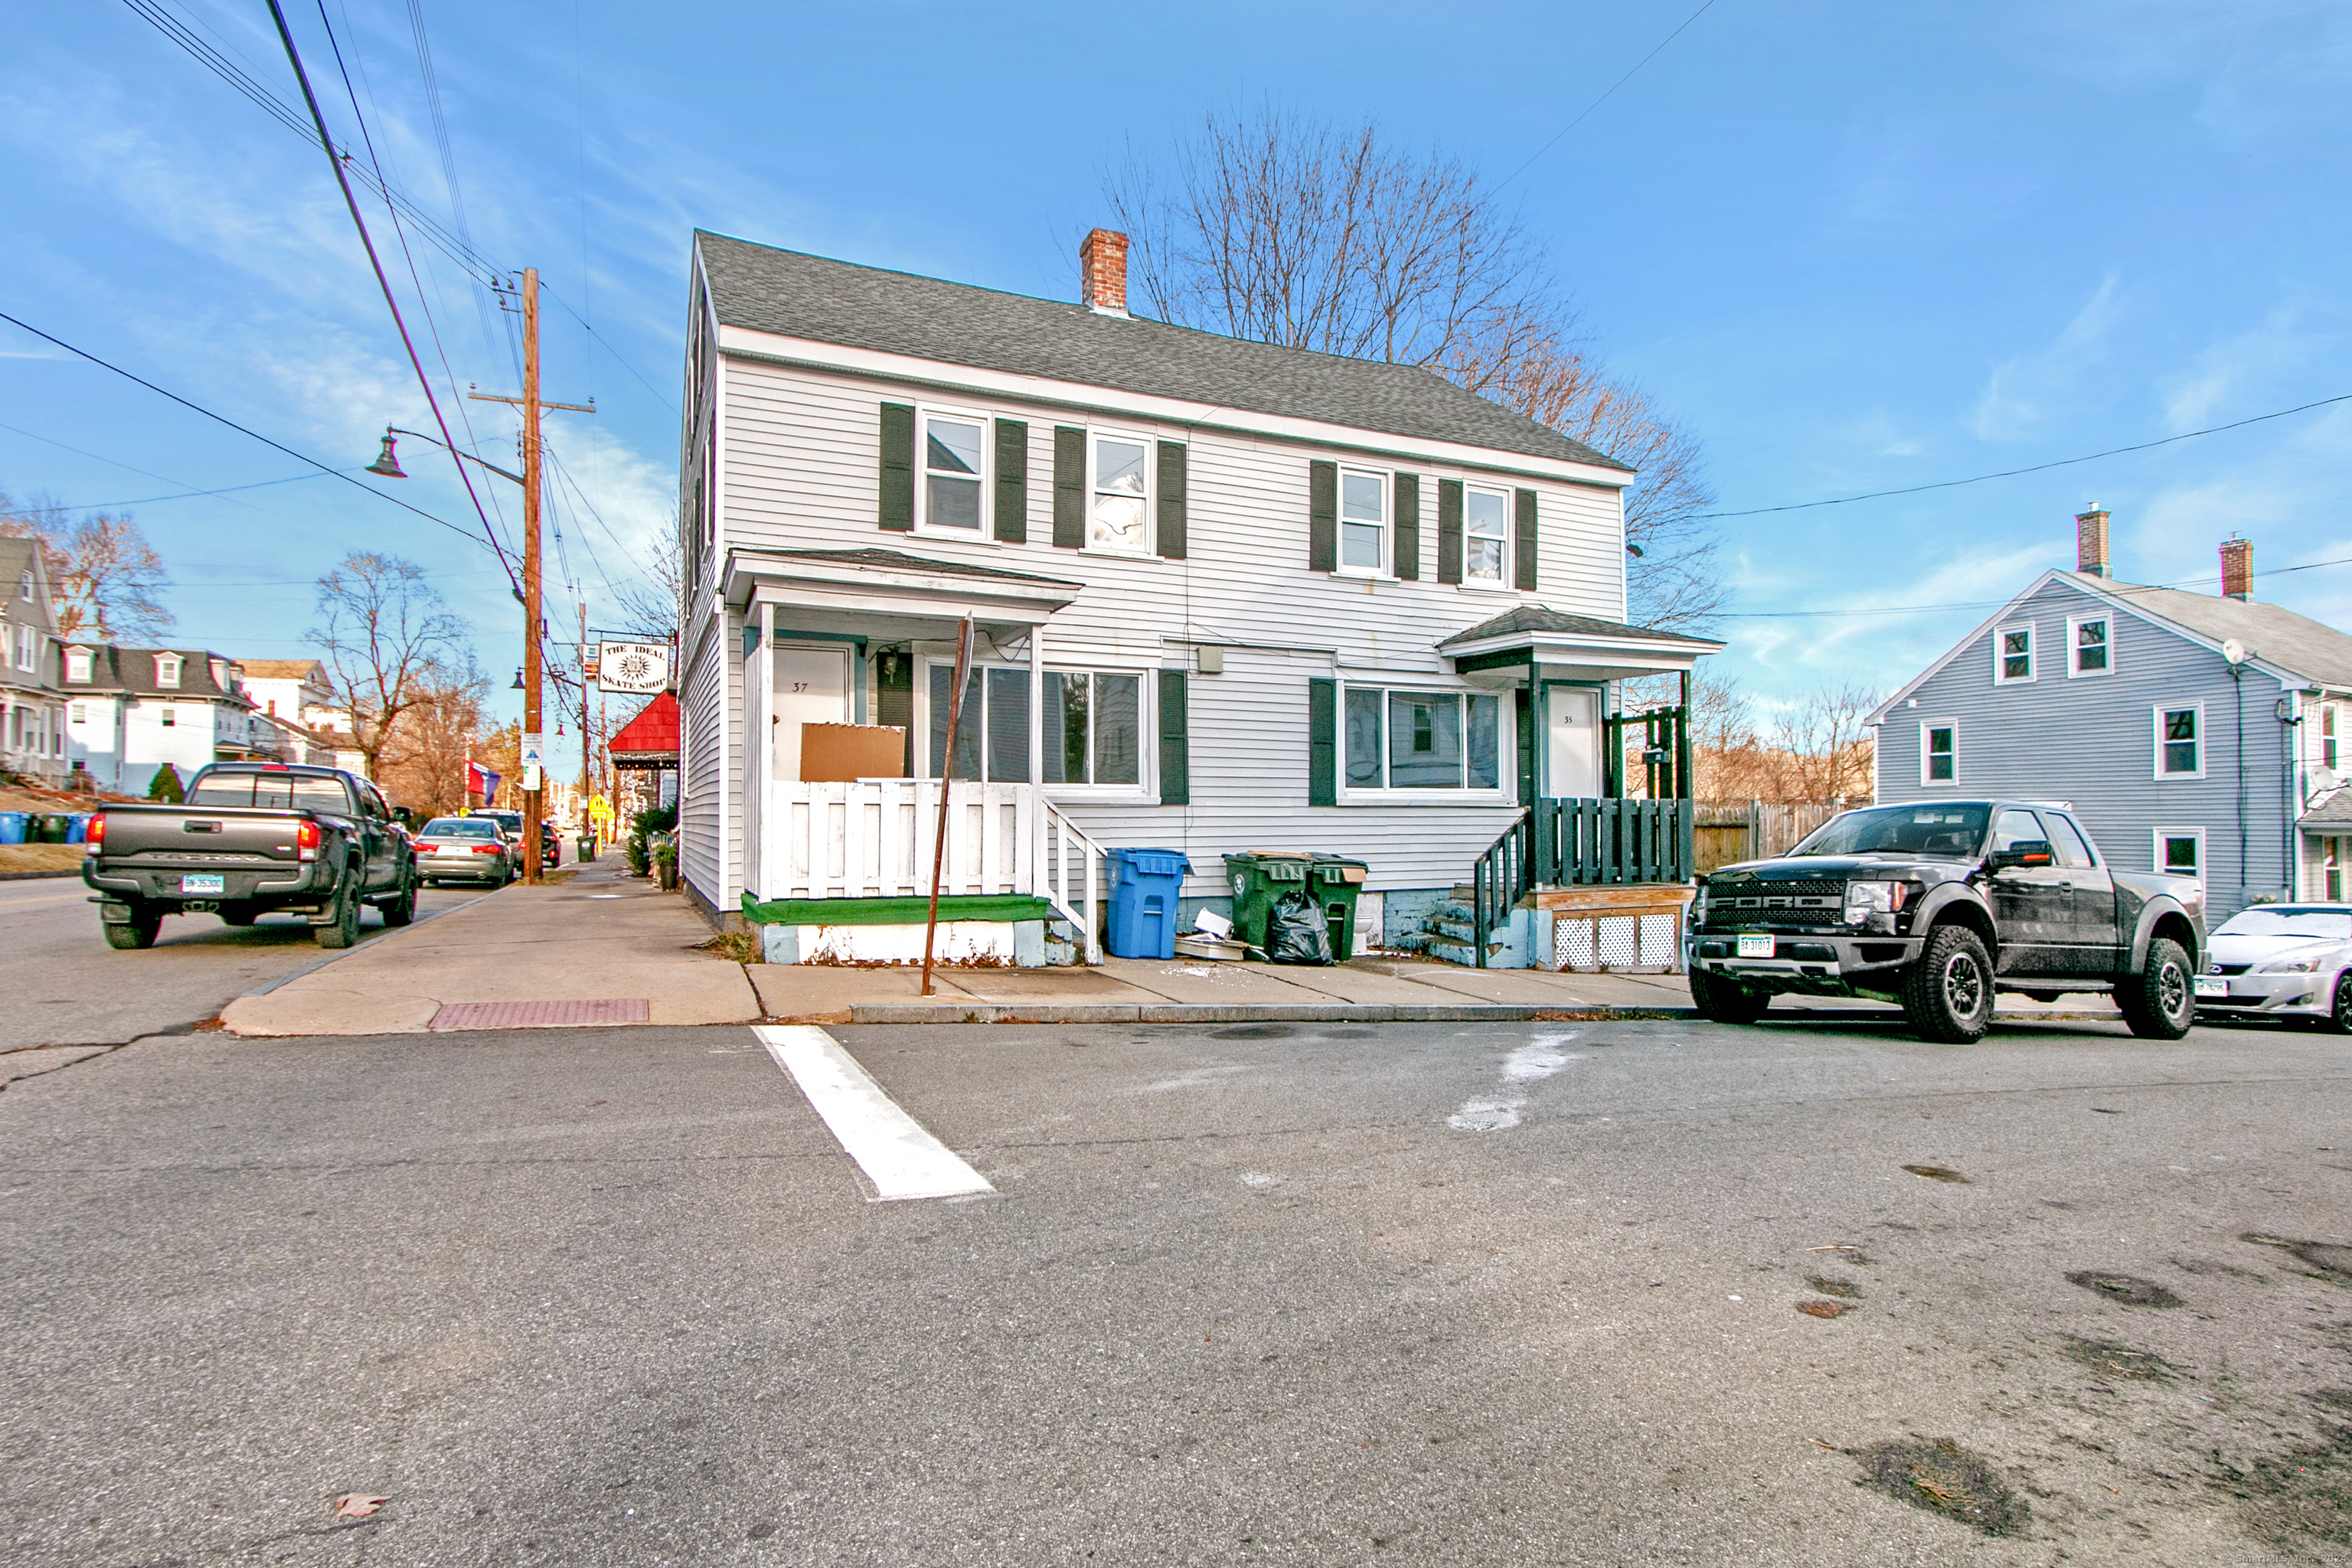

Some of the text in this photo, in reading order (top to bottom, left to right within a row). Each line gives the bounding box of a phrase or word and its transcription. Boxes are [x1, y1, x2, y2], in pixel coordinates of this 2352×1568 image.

[605, 645, 665, 660] THE IDEAL
[601, 674, 666, 690] SKATE SHOP
[792, 682, 808, 692] 37
[149, 853, 260, 862] TACOMA
[1708, 896, 1841, 908] FORD
